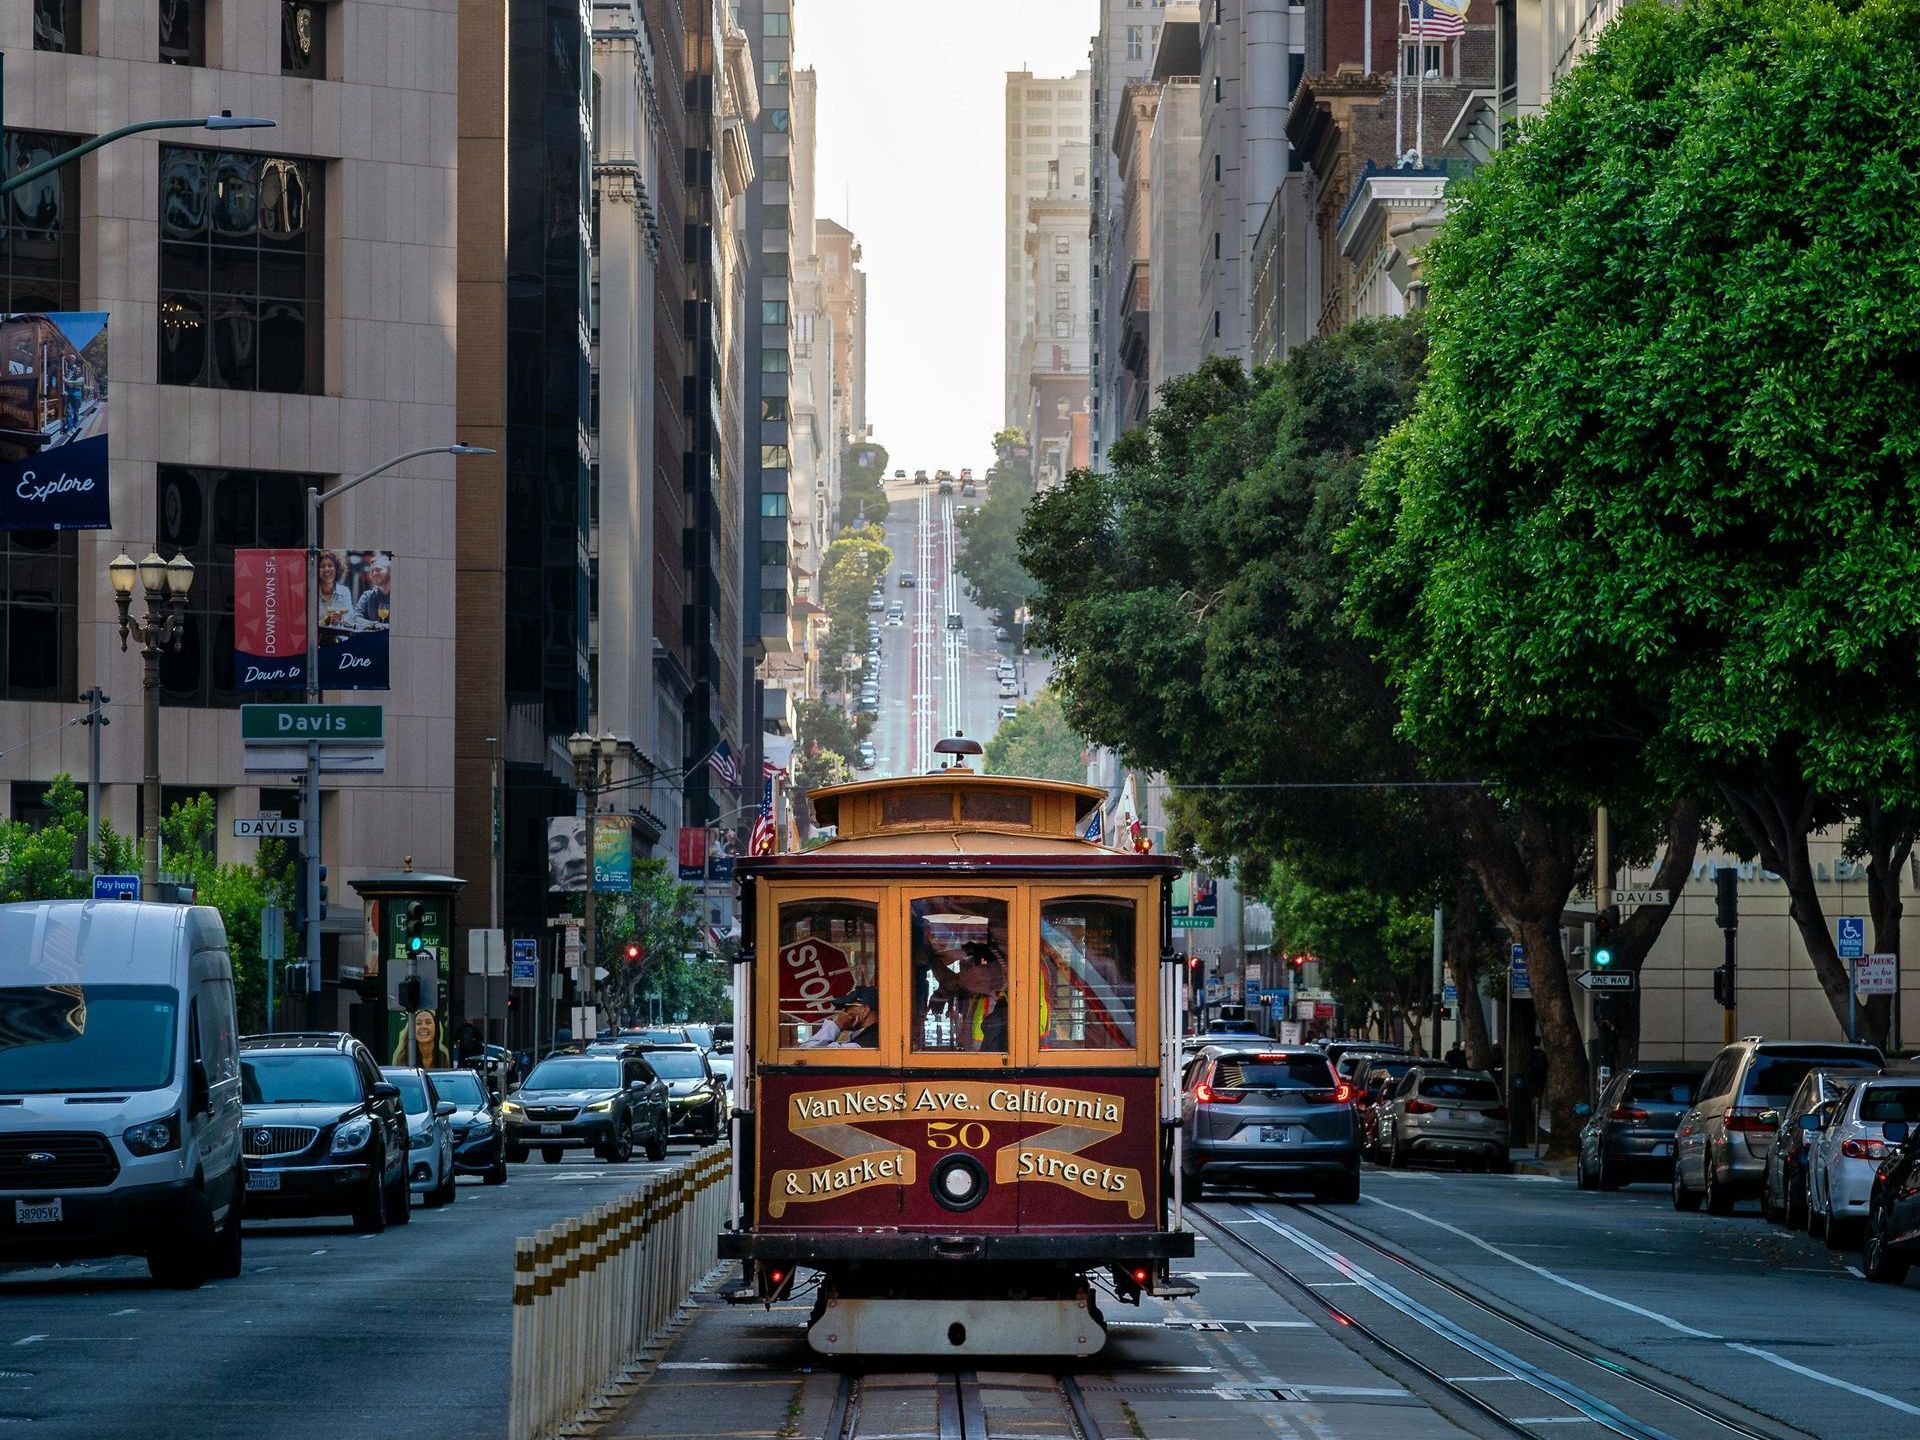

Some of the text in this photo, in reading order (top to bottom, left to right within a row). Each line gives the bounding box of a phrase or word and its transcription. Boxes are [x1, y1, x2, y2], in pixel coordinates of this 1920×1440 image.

[16, 471, 95, 502] Explore
[265, 561, 276, 654] DOWNTOWN SF
[339, 653, 371, 670] Dine
[245, 666, 300, 683] Down to
[278, 713, 347, 731] Davis
[241, 822, 298, 833] DAVIS
[97, 881, 135, 891] Pay here
[1616, 892, 1664, 902] DAVIS
[787, 944, 836, 1011] STOP
[796, 1096, 840, 1120] Van
[843, 1091, 906, 1116] Ness
[988, 1088, 1118, 1122] California
[927, 1122, 990, 1150] 50
[784, 1152, 1128, 1196] & Market Streets
